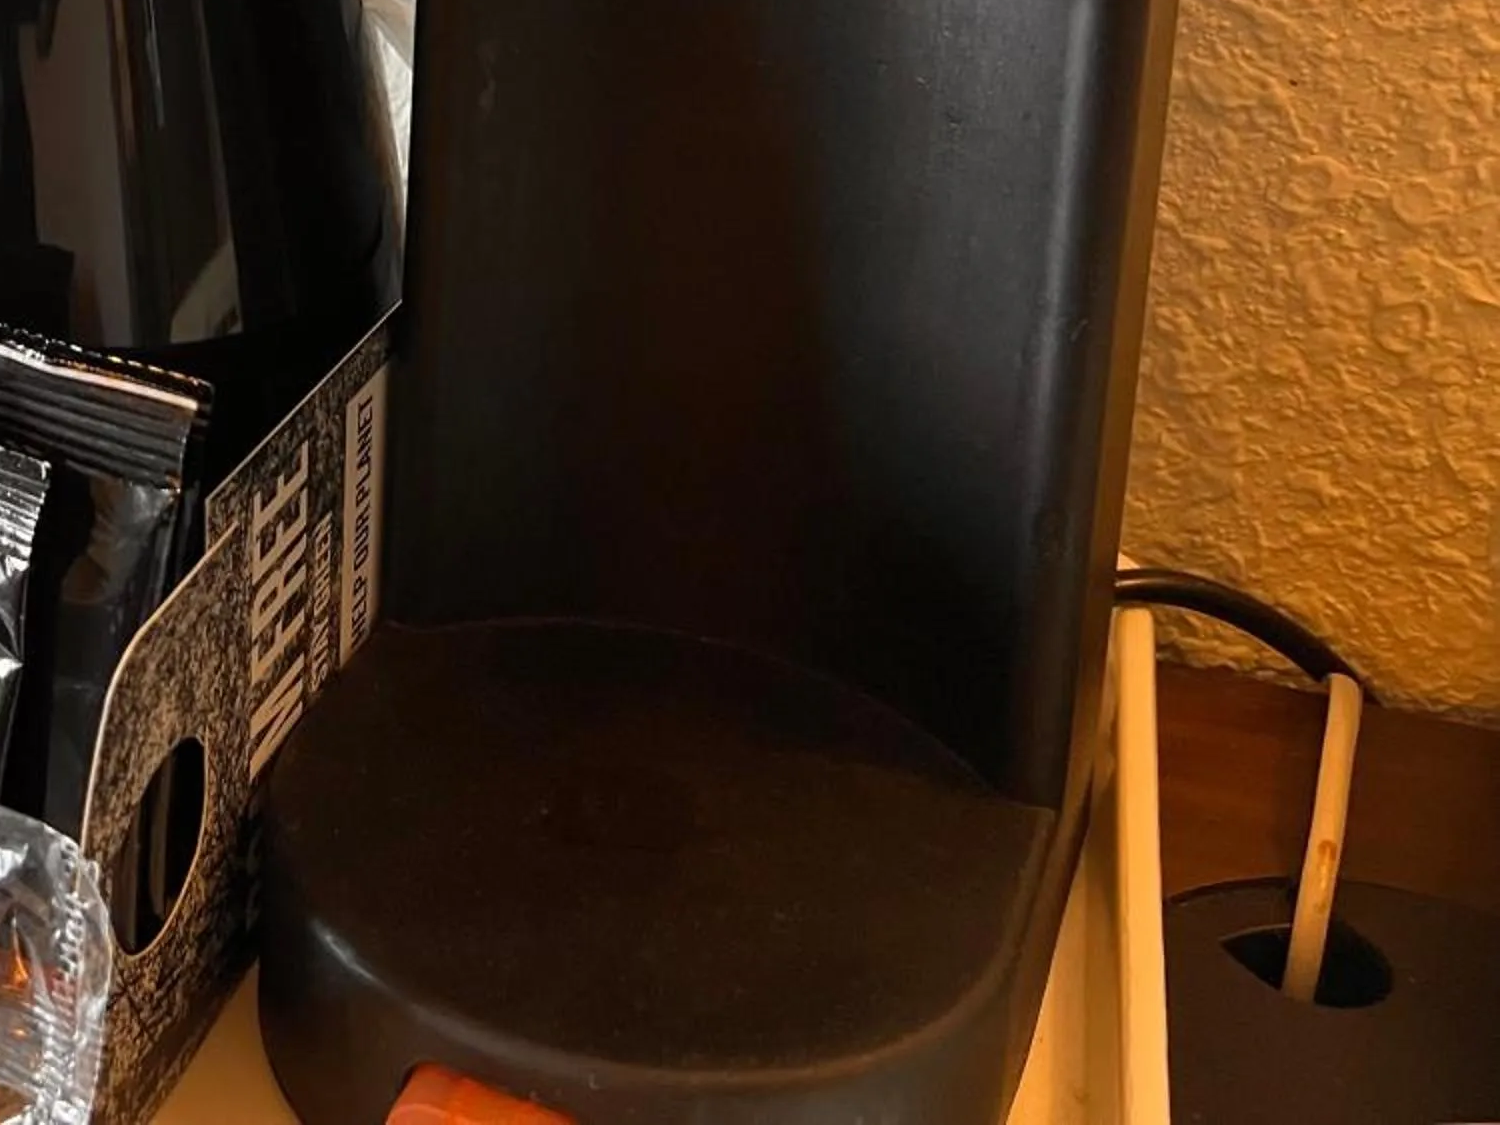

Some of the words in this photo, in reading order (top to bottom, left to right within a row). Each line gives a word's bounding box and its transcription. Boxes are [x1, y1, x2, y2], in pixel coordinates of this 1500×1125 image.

[355, 394, 374, 513] PLANET
[251, 440, 308, 691] FREE
[313, 511, 332, 619] GREEN
[353, 507, 370, 573] OUR
[311, 615, 329, 693] STAY
[351, 574, 368, 651] HELP
